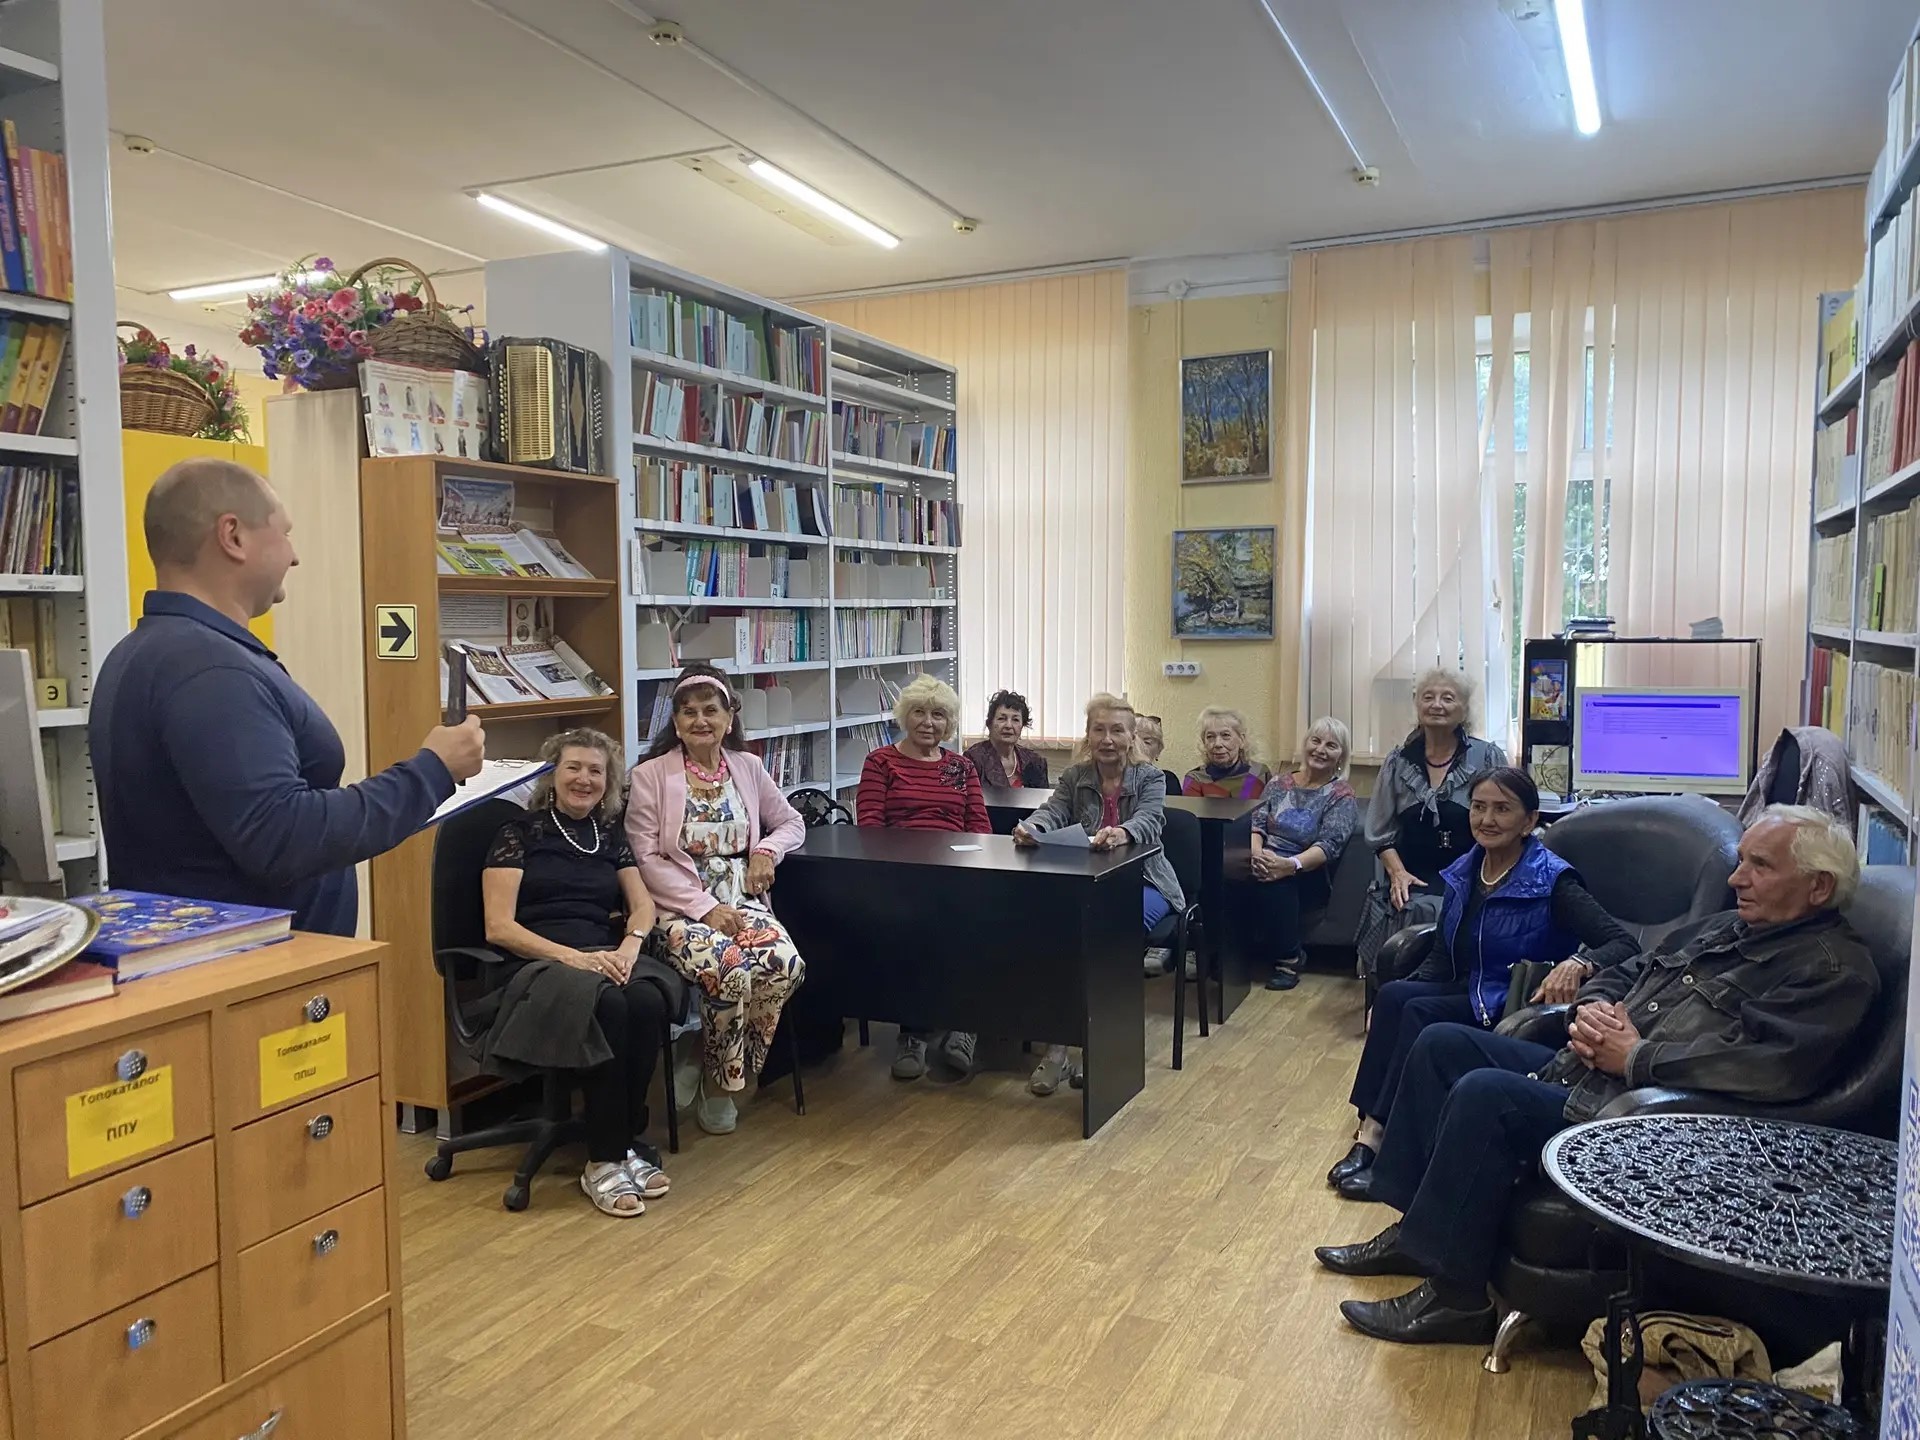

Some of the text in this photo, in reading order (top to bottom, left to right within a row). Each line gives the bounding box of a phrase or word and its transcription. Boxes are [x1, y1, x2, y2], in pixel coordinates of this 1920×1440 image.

[47, 685, 59, 701] Э
[277, 1033, 332, 1057] Топокаталог
[79, 1073, 160, 1107] Топокаталог
[106, 1119, 138, 1141] ППУ
